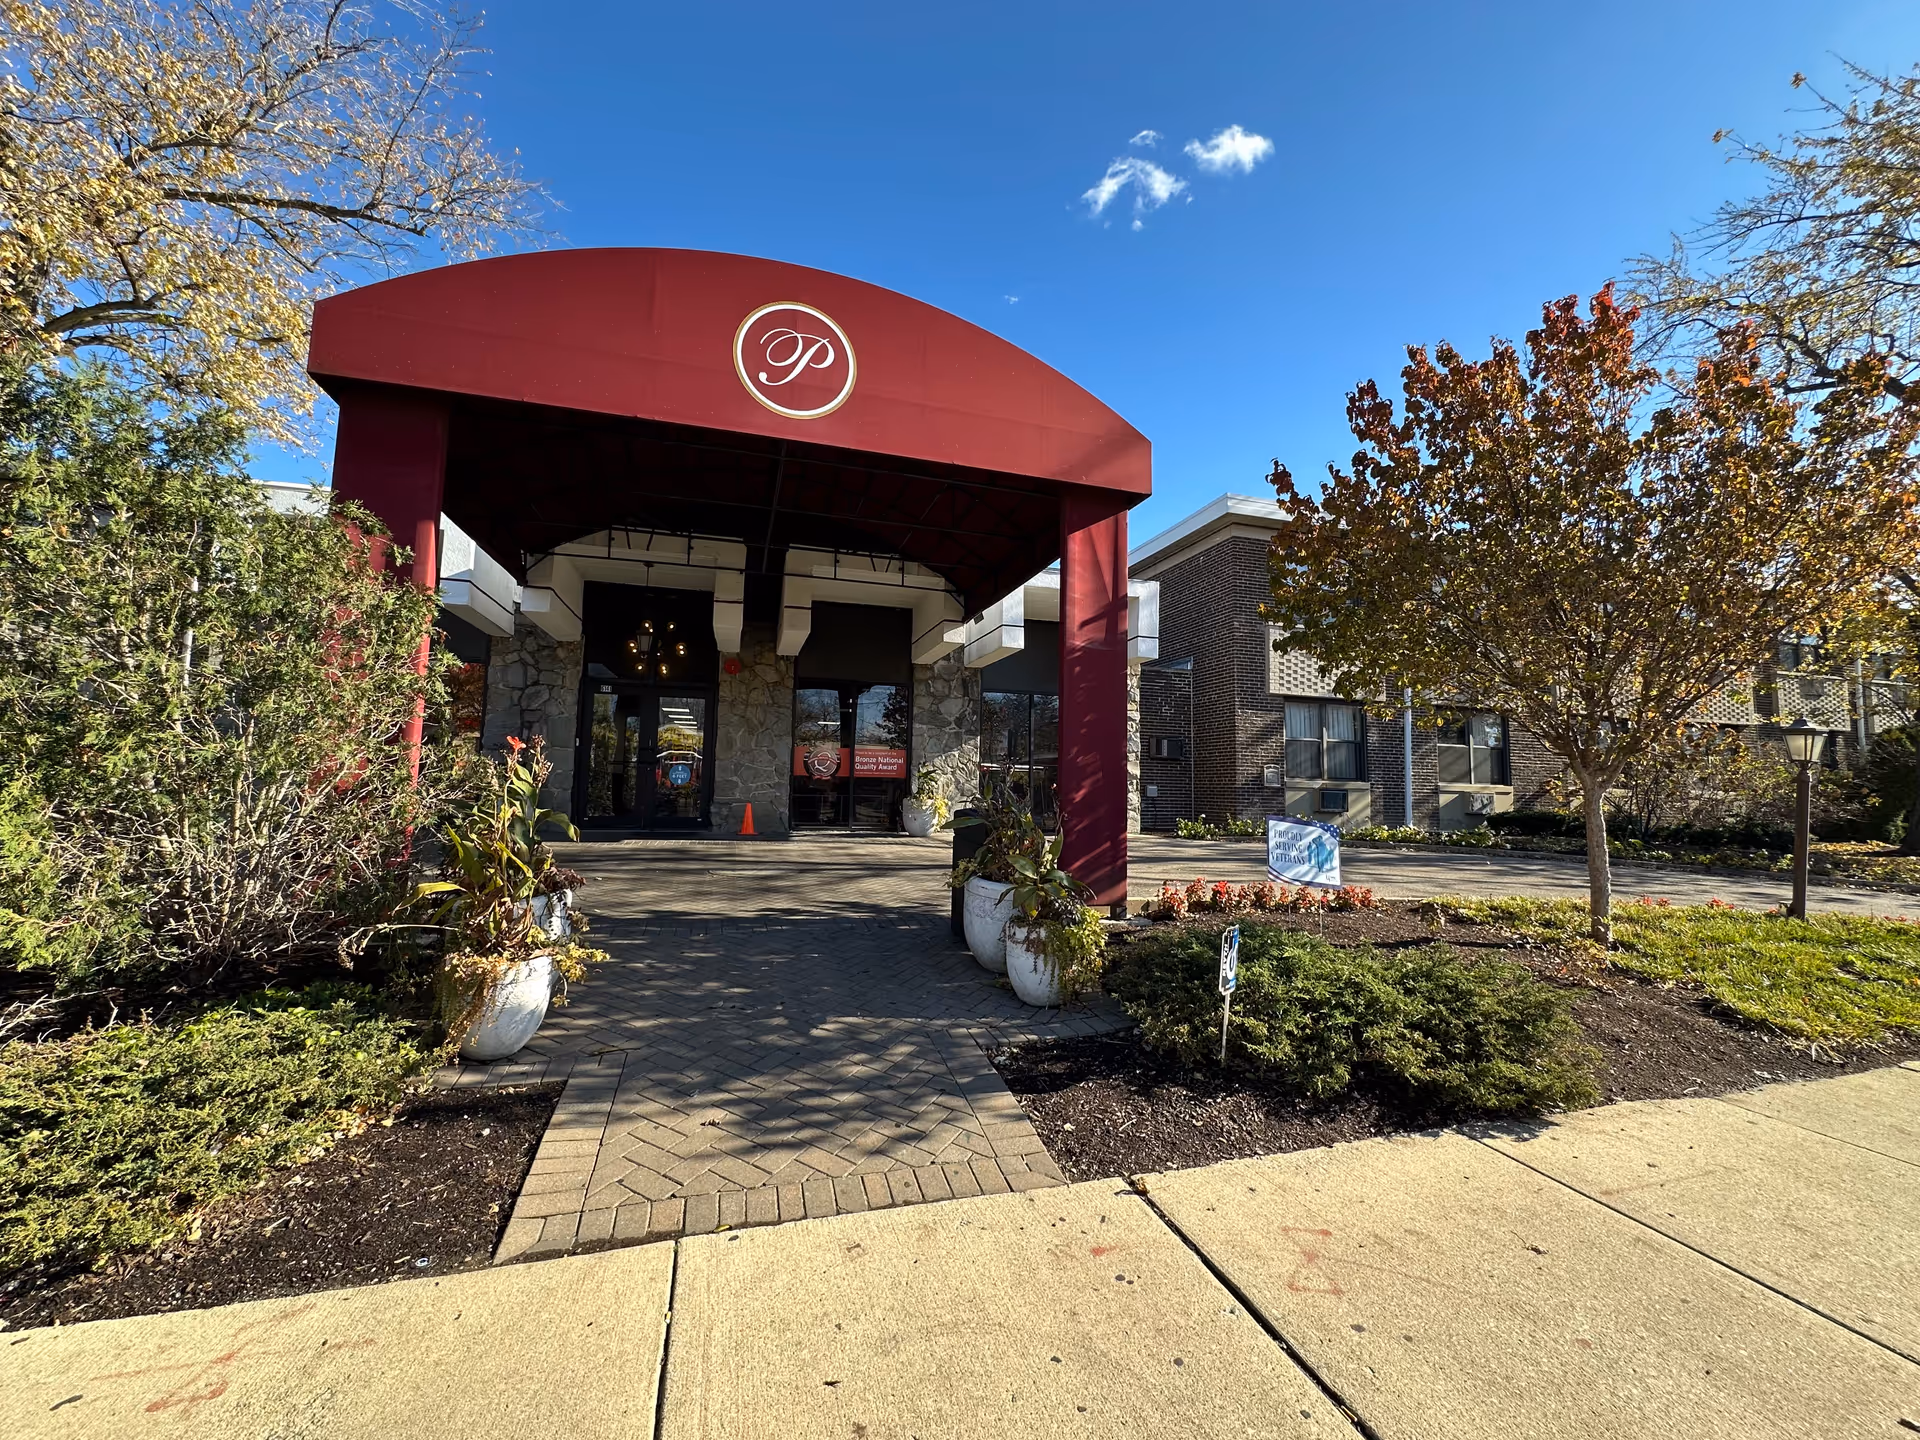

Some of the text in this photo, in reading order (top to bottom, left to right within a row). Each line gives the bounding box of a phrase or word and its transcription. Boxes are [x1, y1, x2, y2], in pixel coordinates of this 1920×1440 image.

[758, 328, 835, 386] P
[1273, 828, 1304, 842] PROUDLY
[1274, 840, 1303, 854] SERVING
[1270, 851, 1306, 866] VETERANS
